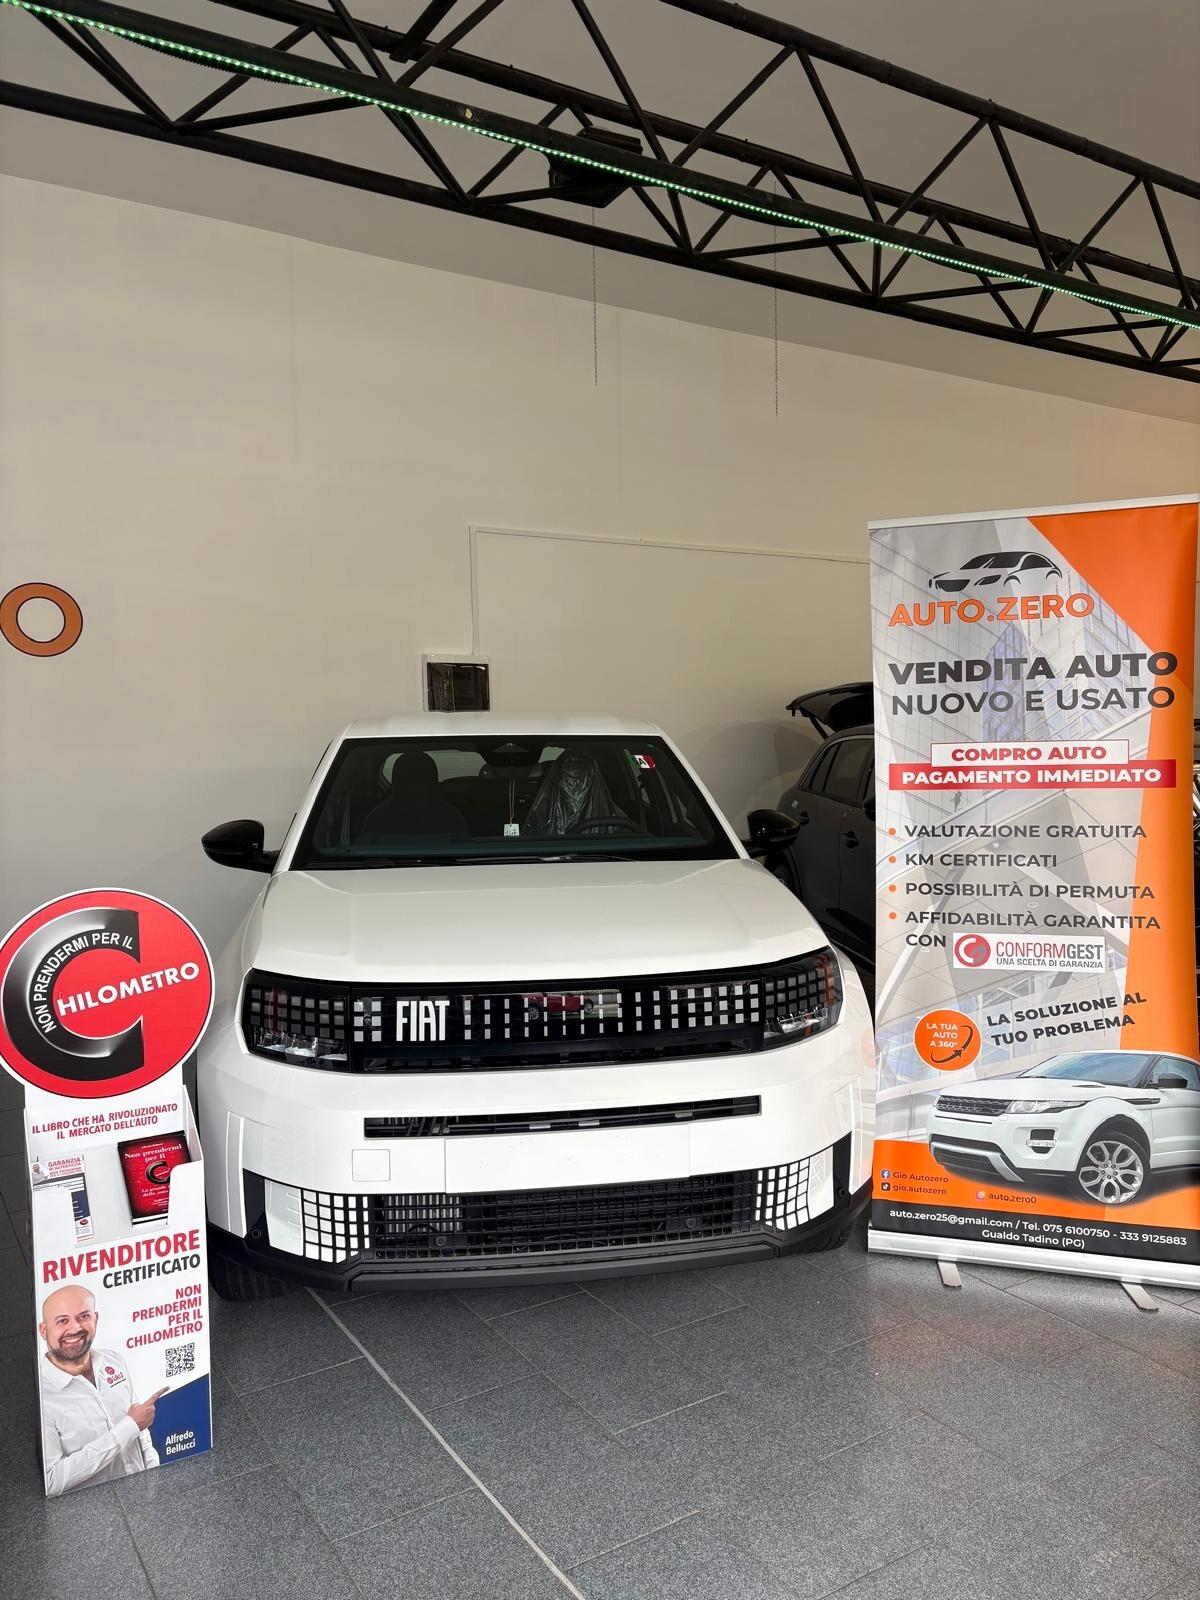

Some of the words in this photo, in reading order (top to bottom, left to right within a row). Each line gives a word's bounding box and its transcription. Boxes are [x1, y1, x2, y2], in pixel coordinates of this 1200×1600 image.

[888, 592, 1095, 627] AUTO.ZERO
[888, 657, 1055, 685] VENDITA
[1065, 651, 1178, 678] AUTO
[891, 691, 1014, 716] NUOVO
[1025, 690, 1044, 712] E
[1056, 686, 1176, 710] USATO
[951, 747, 1042, 762] COMPRO
[1047, 745, 1107, 760] AUTO
[902, 771, 1031, 785] PAGAMENTO
[1037, 768, 1162, 784] IMMEDIATO
[904, 825, 1041, 839] VALUTAZIONE
[1046, 825, 1147, 839] GRATUITA
[905, 853, 934, 867] KM
[939, 854, 1058, 868] CERTIFICATI
[905, 880, 1024, 897] POSSIBILITÀ
[1029, 884, 1050, 898] DI
[1056, 885, 1155, 899] PERMUTA
[905, 910, 1038, 926] AFFIDABILITÀ
[1043, 915, 1161, 930] GARANTITA
[92, 932, 119, 946] PER
[122, 935, 133, 950] IL
[905, 933, 947, 948] CON
[996, 941, 1103, 960] CONFORMGEST
[33, 935, 89, 1001] PRENDERMI
[996, 958, 1015, 966] UNA
[1016, 959, 1047, 967] SCELTA
[1059, 960, 1103, 969] GARANZIA
[987, 1013, 1010, 1027] LA
[1014, 995, 1118, 1023] SOLUZIONE
[1123, 991, 1147, 1006] AL
[34, 1005, 57, 1034] NON
[396, 1000, 450, 1041] FIAT
[926, 1022, 938, 1030] LA
[940, 1023, 958, 1031] TUA
[933, 1031, 958, 1039] AUTO
[990, 1030, 1028, 1047] TUO
[1033, 1013, 1136, 1040] PROBLEMA
[938, 1040, 959, 1048] 360°
[32, 1125, 41, 1134] IL
[42, 1120, 70, 1133] LIBRO
[72, 1116, 90, 1128] CHE
[92, 1115, 104, 1124] HA
[109, 1103, 178, 1122] RIVOLUZIONATO
[57, 1131, 65, 1140] IL
[69, 1123, 111, 1138] MERCATO
[114, 1115, 158, 1131] DELL'AUTO
[142, 1143, 182, 1158] prendermi
[48, 1156, 81, 1167] GARANZIA
[893, 1171, 908, 1180] Gio
[909, 1173, 949, 1183] Autozero
[892, 1184, 947, 1195] gio.autozero
[889, 1209, 1013, 1228] auto.zero25@gmail.com
[1022, 1221, 1040, 1231] Tel.
[1043, 1223, 1063, 1233] 075
[1065, 1225, 1110, 1238] 6100750
[1119, 1231, 1139, 1241] 333
[1142, 1233, 1187, 1246] 9125883
[982, 1229, 1020, 1242] Gualdo
[1022, 1233, 1059, 1245] Tadino
[1062, 1237, 1085, 1249] (PG)
[43, 1229, 200, 1284] RIVENDITORE
[103, 1253, 201, 1289] CERTIFICATO
[175, 1283, 201, 1299] NON
[132, 1295, 201, 1322] PRENDERMI
[168, 1311, 190, 1326] PER
[193, 1308, 203, 1319] IL
[126, 1320, 203, 1349] CHILOMETRO
[165, 1429, 194, 1446] Alfredo
[165, 1438, 196, 1455] Bellucci
